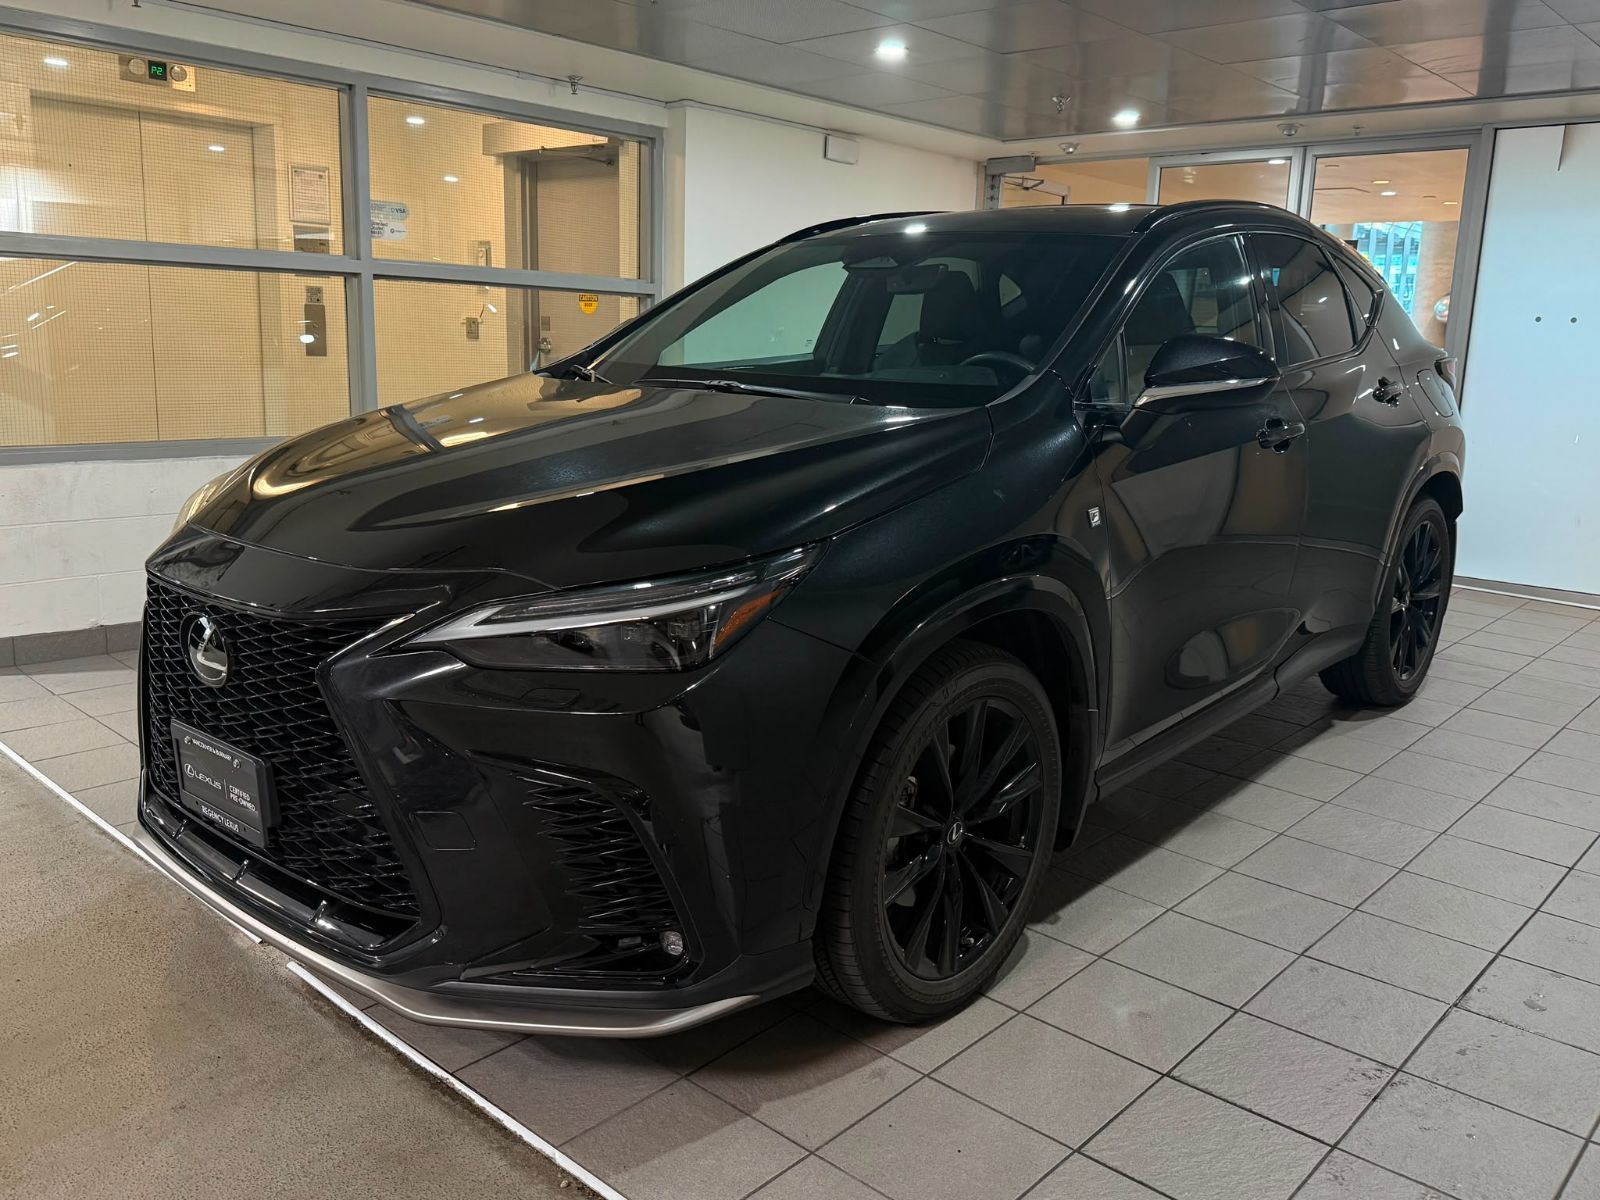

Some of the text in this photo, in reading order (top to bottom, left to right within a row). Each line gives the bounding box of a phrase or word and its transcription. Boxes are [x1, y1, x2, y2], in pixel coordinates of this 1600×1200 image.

[151, 66, 163, 76] P2
[195, 770, 222, 790] LEXUS
[229, 785, 251, 801] CERTIFIED
[230, 793, 256, 812] PRE-OWNED
[201, 805, 239, 833] REGENCY LEXUS
